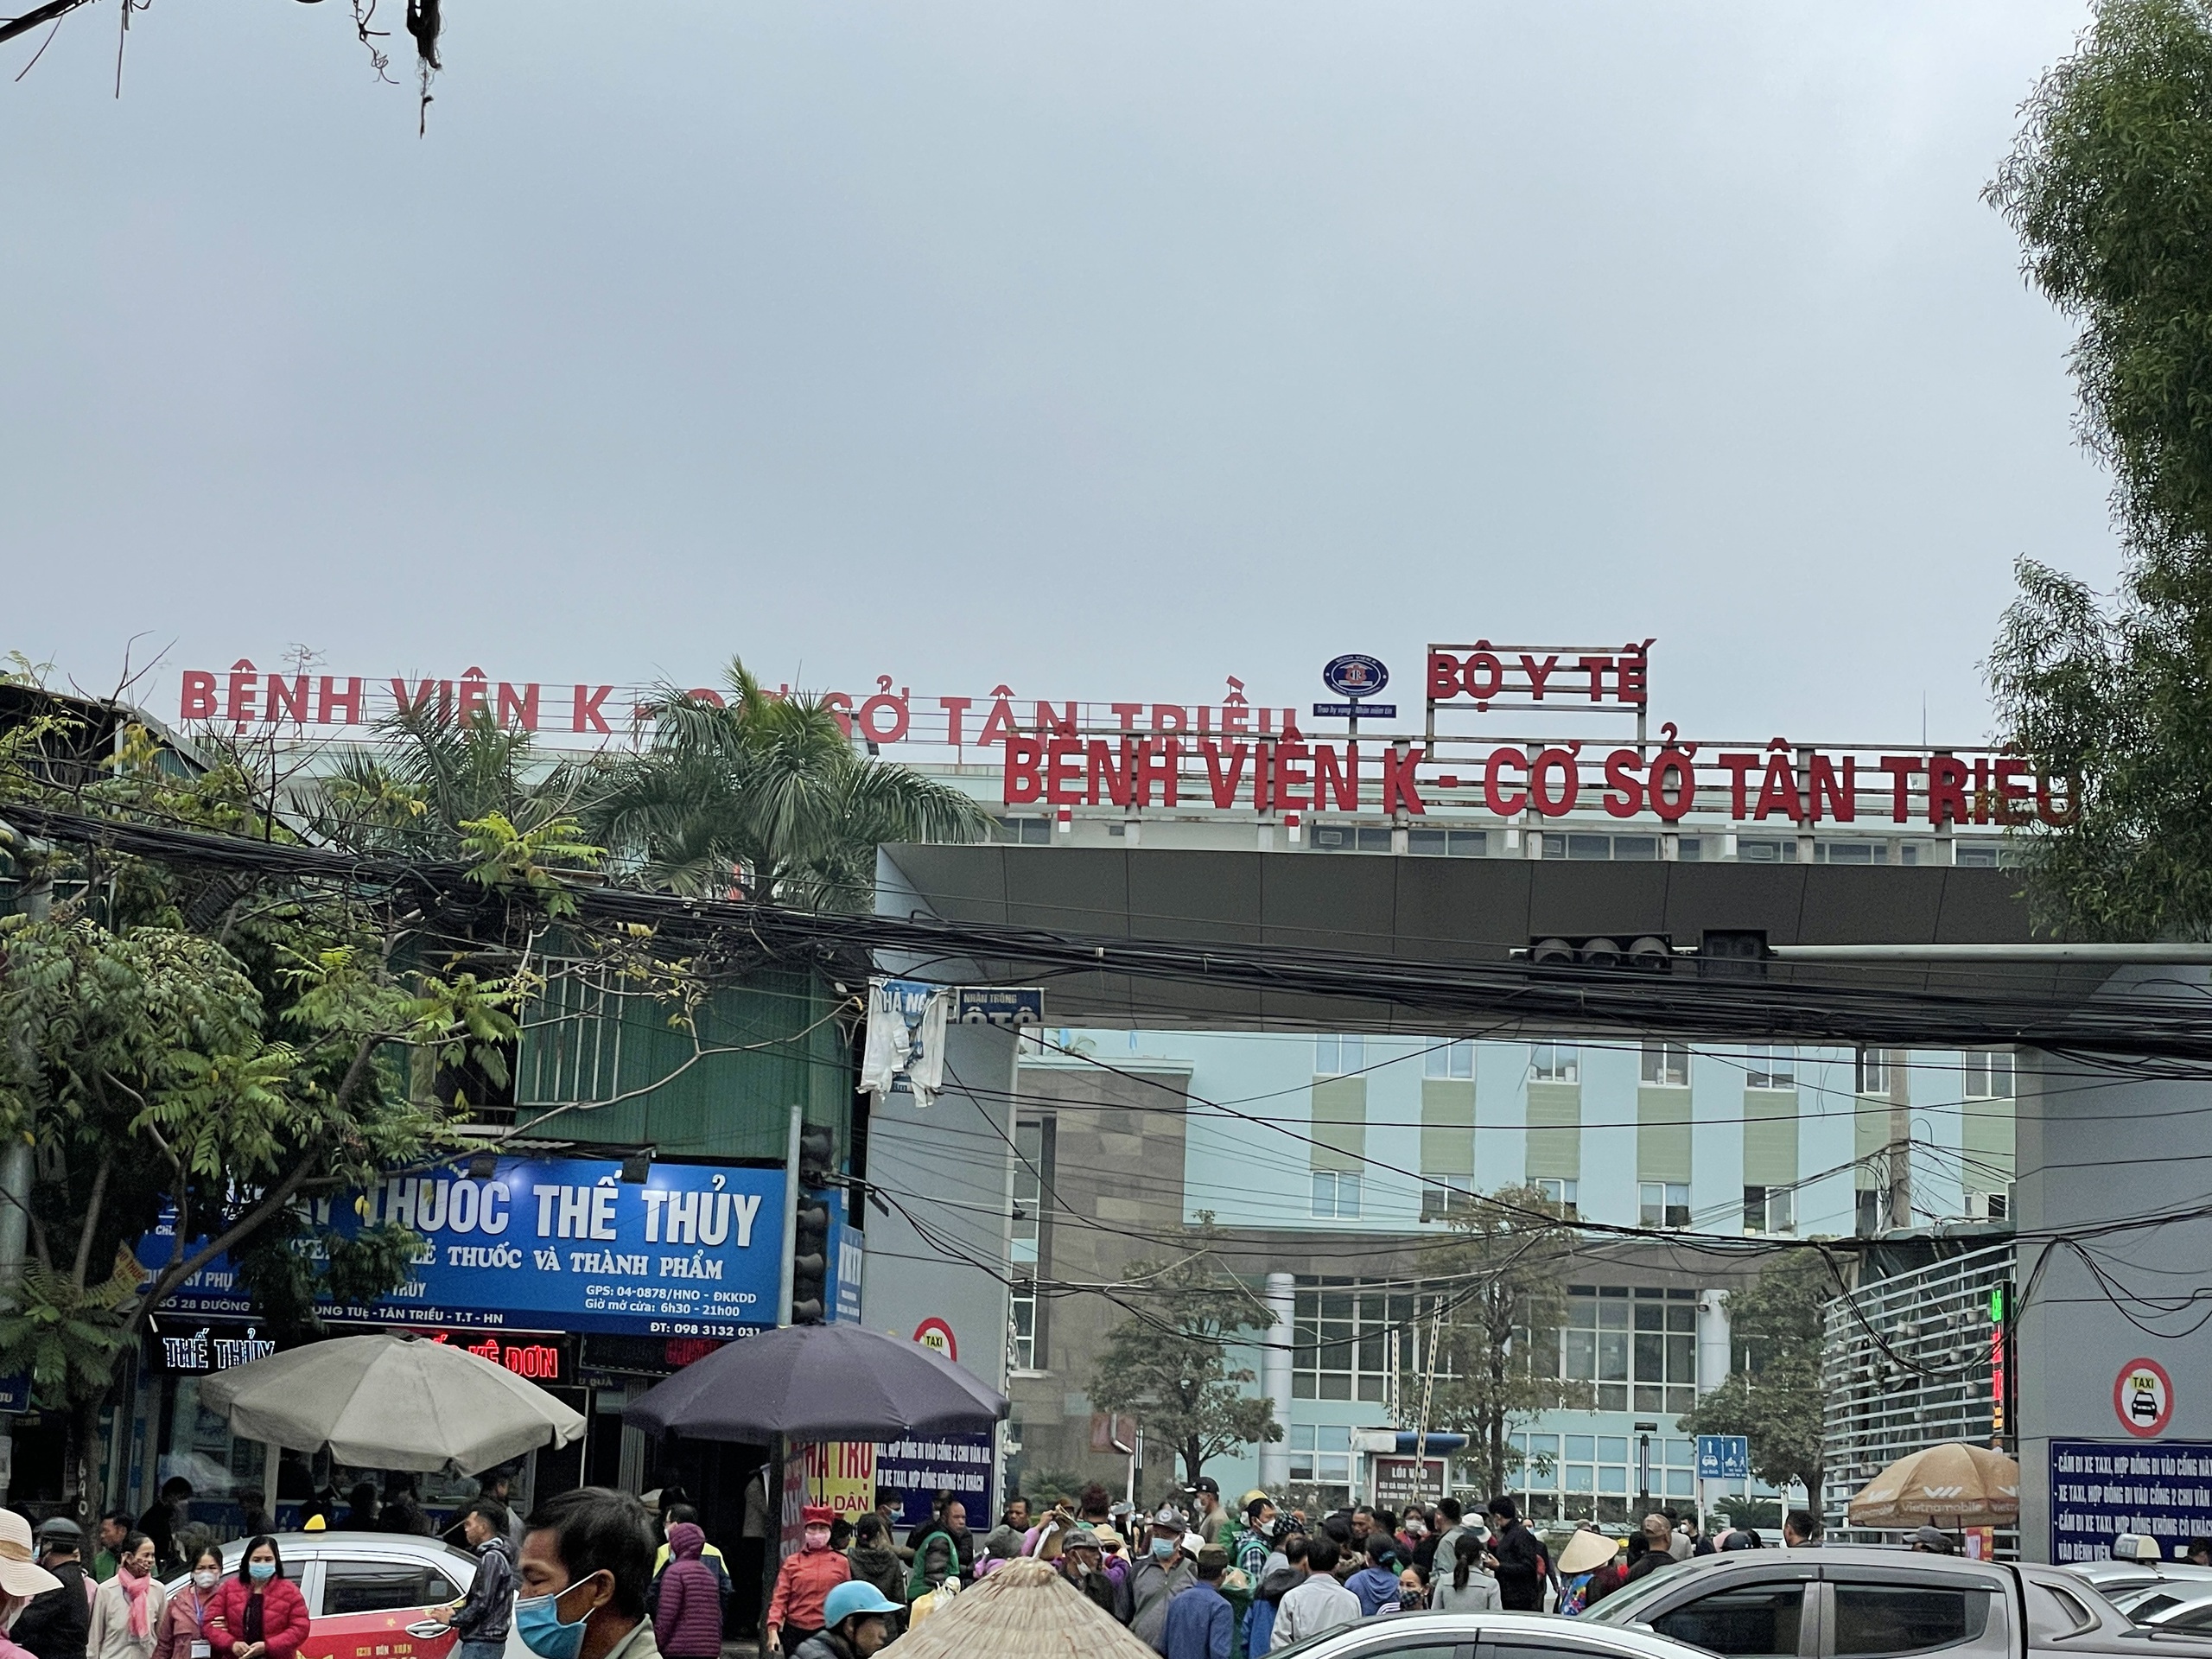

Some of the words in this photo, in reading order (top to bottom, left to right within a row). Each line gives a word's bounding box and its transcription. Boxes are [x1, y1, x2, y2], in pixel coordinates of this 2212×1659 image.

[1427, 639, 1502, 712] BỘ
[1519, 655, 1559, 701] Y
[1579, 639, 1657, 703] TẾ
[182, 658, 361, 734] BỆNH
[573, 685, 614, 734] K
[940, 684, 1078, 748] TÂN
[1005, 721, 1178, 822] BỆNH
[1204, 726, 1358, 827] VIỆN
[1384, 748, 1426, 815] K
[1484, 741, 1581, 817] CƠ
[1603, 722, 1697, 820] SỞ
[1719, 737, 1855, 822] TÂN
[533, 1169, 623, 1240] THẾ
[641, 1174, 762, 1247] THỦY
[447, 1242, 522, 1269] THUỐC
[533, 1246, 561, 1271] VÀ
[569, 1249, 649, 1275] THÀNH
[659, 1249, 724, 1280] PHẨM
[205, 1272, 233, 1292] PHỤ
[586, 1285, 613, 1296] GPS:
[616, 1286, 700, 1300] 04-0878/HNO
[180, 1299, 196, 1309] 28
[200, 1298, 251, 1311] ĐƯỜNG
[585, 1298, 606, 1309] Giờ
[607, 1300, 628, 1311] mở
[629, 1301, 656, 1313] cửa:
[660, 1303, 691, 1313] 6h30
[702, 1305, 741, 1316] 21h00
[379, 1306, 405, 1319] TÂN
[484, 1313, 504, 1324] HN
[650, 1322, 671, 1332] ĐT:
[674, 1324, 699, 1334] 098
[702, 1325, 734, 1337] 3132
[162, 1327, 209, 1369] THẾ
[926, 1336, 943, 1347] TAXI
[505, 1344, 558, 1378] ĐƠN
[2133, 1377, 2154, 1389] TAXI
[1408, 1468, 1427, 1479] VO
[2084, 1456, 2094, 1473] XE
[2094, 1457, 2113, 1476] TAXI,
[2161, 1454, 2176, 1476] VÀO
[834, 1491, 868, 1511] DÂN
[2058, 1484, 2068, 1502] XE
[2069, 1485, 2087, 1504] TAXI,
[2133, 1484, 2148, 1504] VÀO
[2171, 1488, 2177, 1506] 2
[2177, 1489, 2193, 1506] CHU
[2085, 1515, 2094, 1532] XE
[2095, 1516, 2113, 1535] TAXI,
[2058, 1540, 2072, 1560] VÀO
